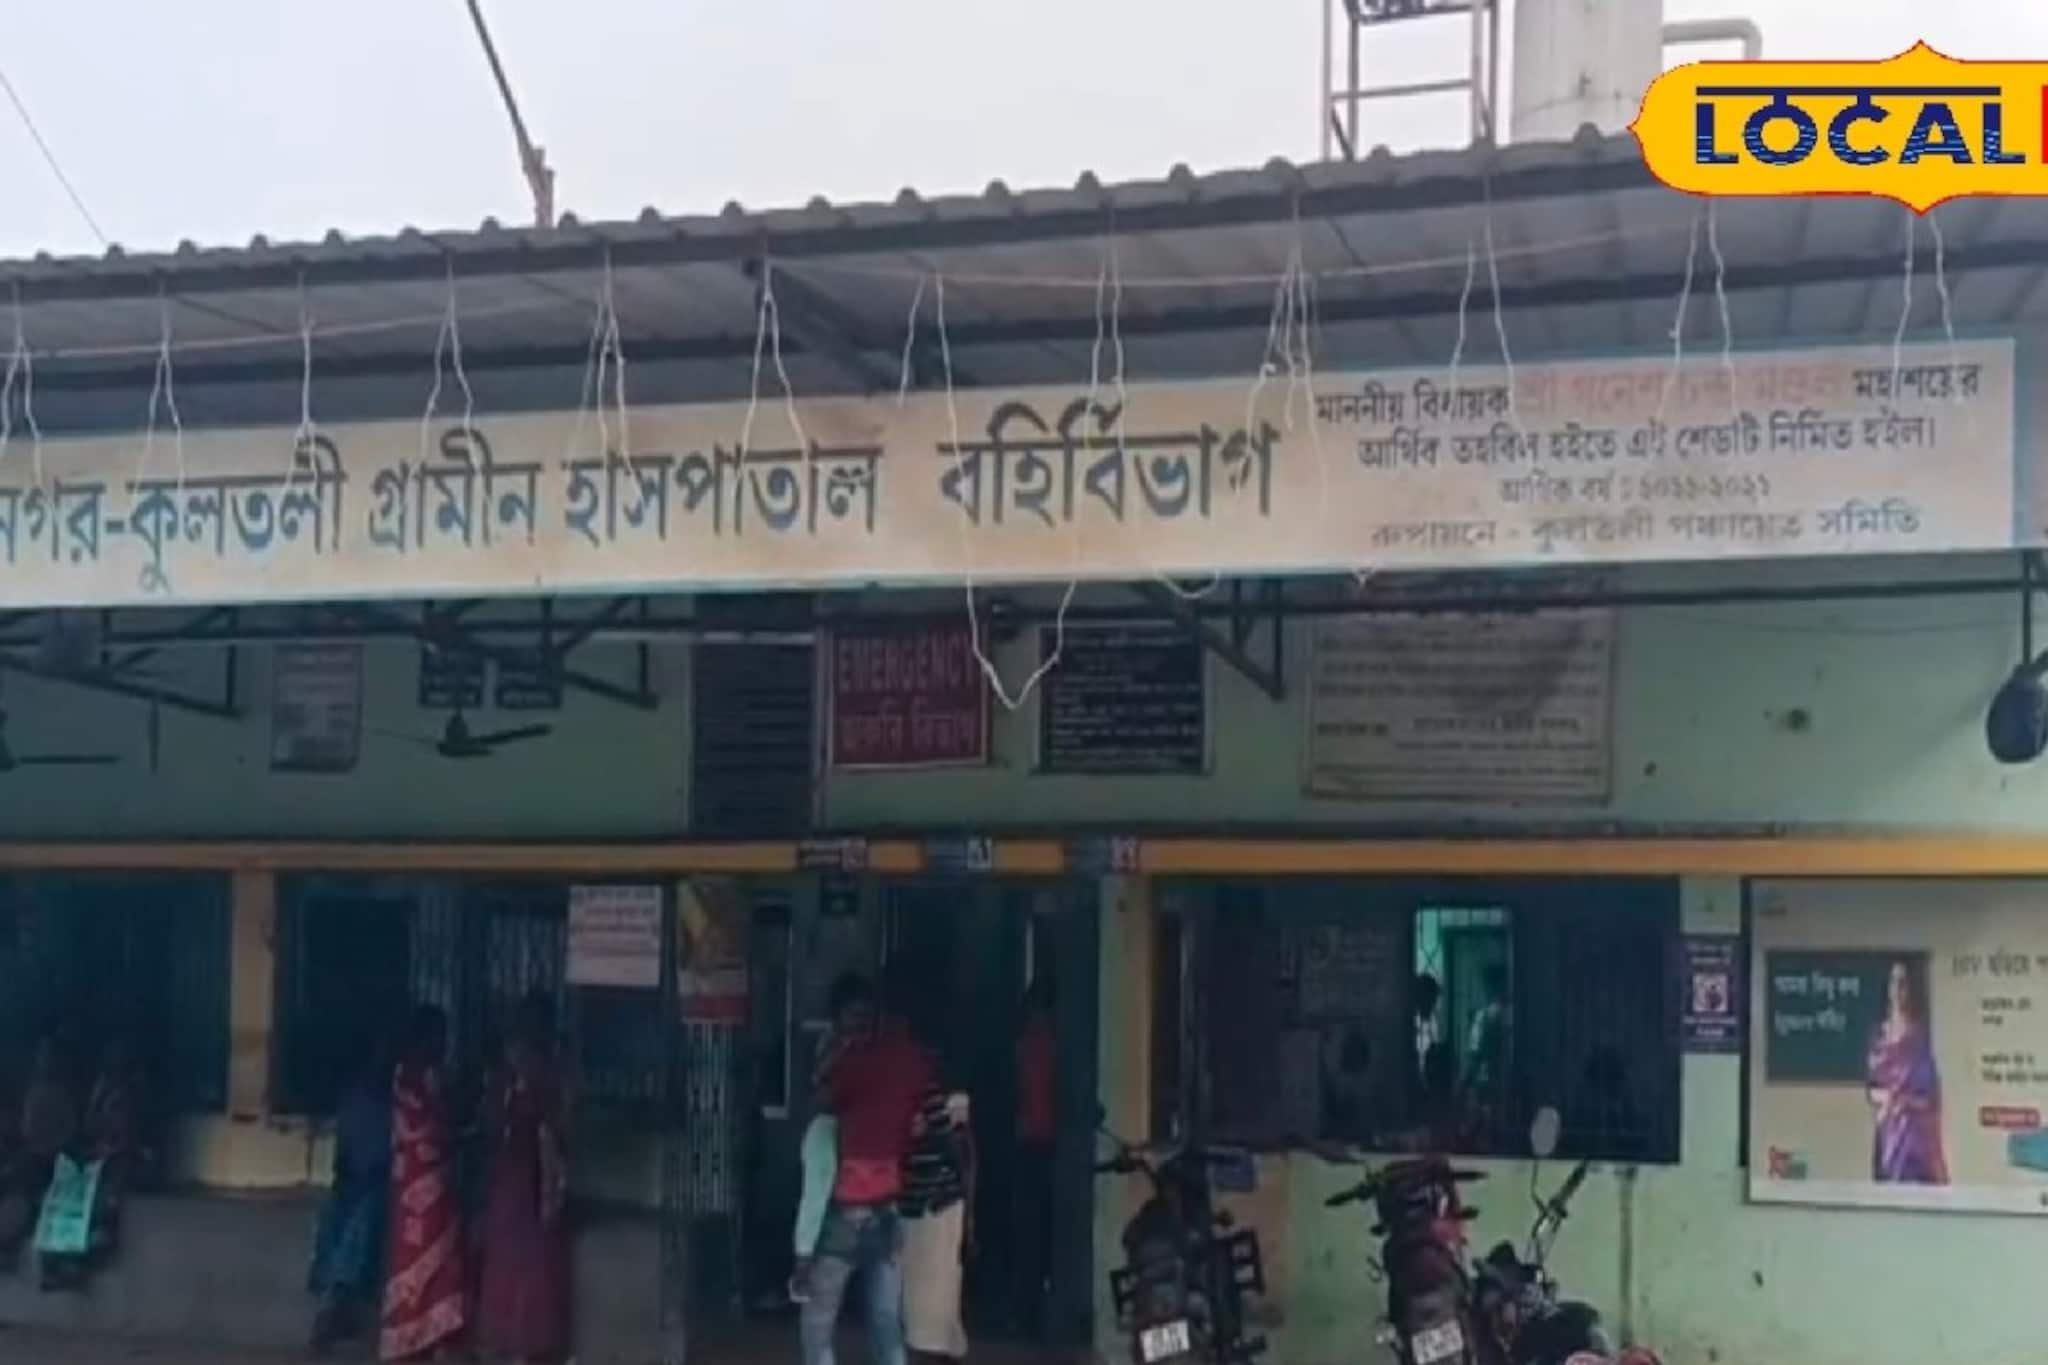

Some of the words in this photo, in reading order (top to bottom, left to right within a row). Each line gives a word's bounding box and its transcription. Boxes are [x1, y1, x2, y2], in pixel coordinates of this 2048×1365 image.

[1316, 380, 1404, 424] মাননীয়
[1852, 362, 1982, 399] মহাশয়ের
[561, 440, 884, 548] হাসপাতাল
[936, 397, 1281, 529] বহির্বিভাগ
[1815, 498, 1921, 537] সমিতি
